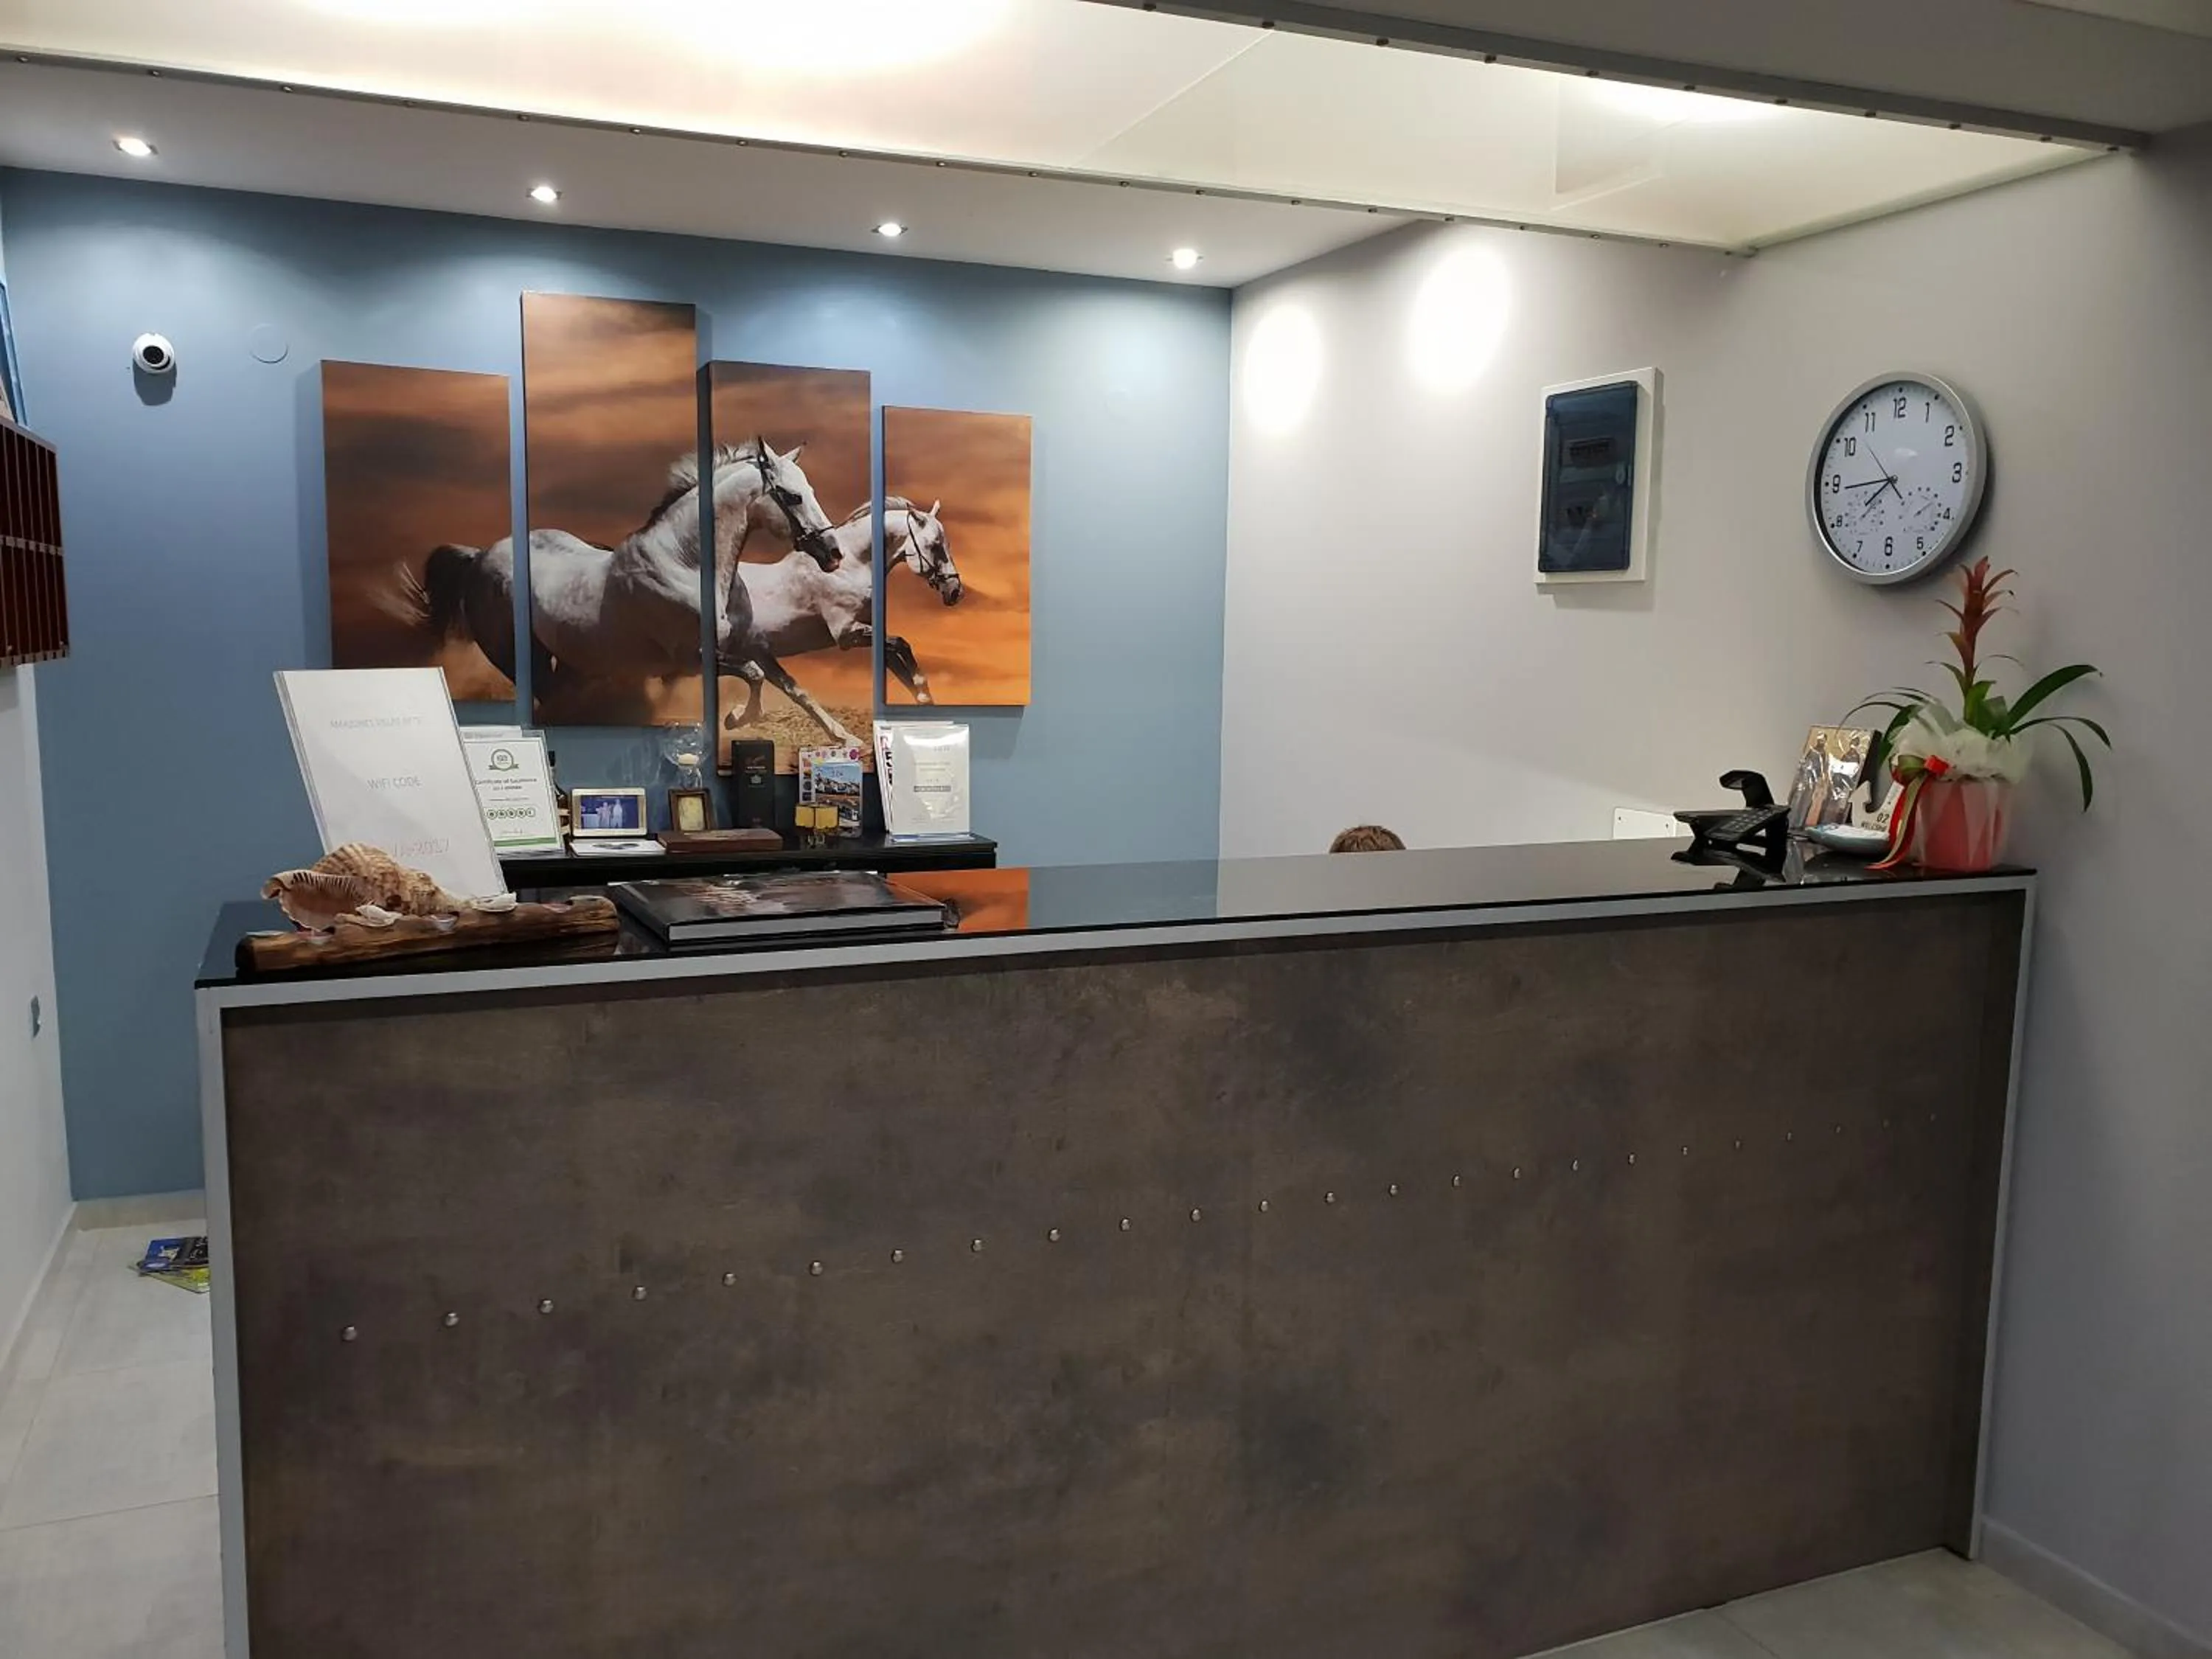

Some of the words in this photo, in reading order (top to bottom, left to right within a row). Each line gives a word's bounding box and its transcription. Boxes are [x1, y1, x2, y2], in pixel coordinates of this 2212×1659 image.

[1893, 397, 1907, 419] 12
[1925, 402, 1930, 422] 1
[1865, 412, 1876, 433] 11
[1944, 425, 1955, 447] 2
[1844, 437, 1857, 457] 10
[1952, 462, 1962, 483] 3
[1832, 474, 1841, 494] 9
[1836, 515, 1843, 528] 8
[1942, 507, 1951, 521] 4
[1856, 540, 1863, 553] 7
[1884, 536, 1893, 557] 6
[1916, 536, 1924, 550] 5
